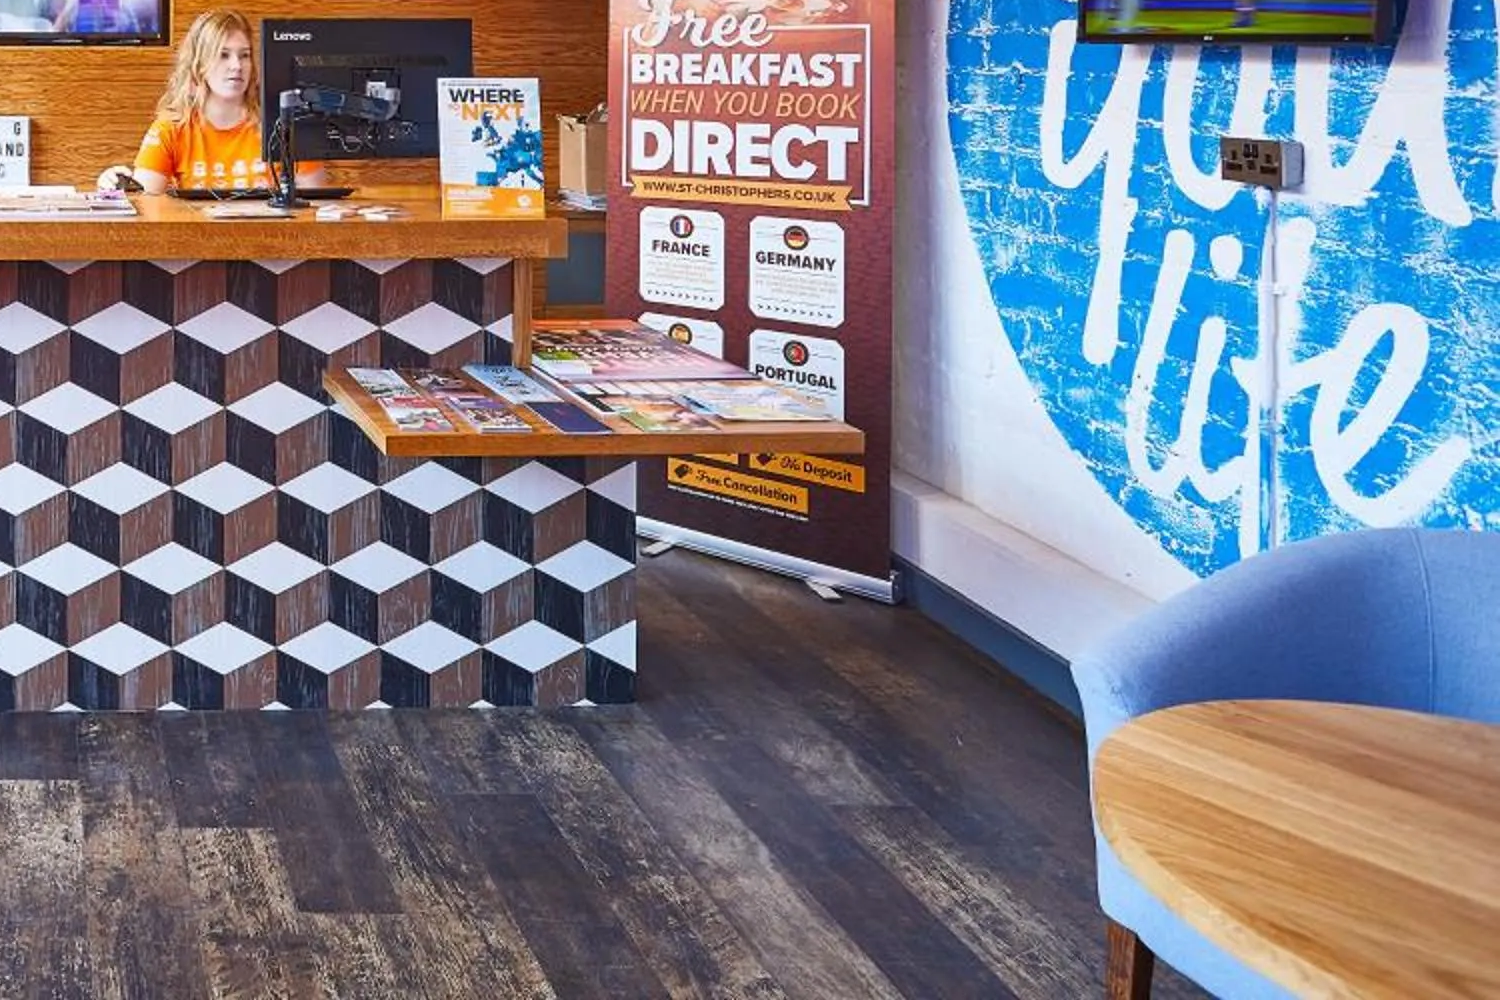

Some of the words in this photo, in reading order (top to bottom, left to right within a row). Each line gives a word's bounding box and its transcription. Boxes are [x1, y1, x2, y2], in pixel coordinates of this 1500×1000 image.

[273, 30, 313, 42] Lenovo
[631, 52, 862, 89] BREAKFAST
[449, 87, 525, 103] WHERE
[630, 88, 706, 116] WHEN
[712, 91, 769, 118] YOU
[775, 93, 861, 120] BOOK
[462, 103, 525, 121] NEXT
[631, 119, 859, 183] DIRECT
[651, 239, 711, 258] FRANCE
[755, 250, 837, 272] GERMANY
[754, 362, 837, 391] PORTUGAL
[1124, 216, 1473, 561] life
[780, 455, 801, 471] No
[803, 461, 853, 484] Deposit
[723, 477, 798, 505] Cancellation
